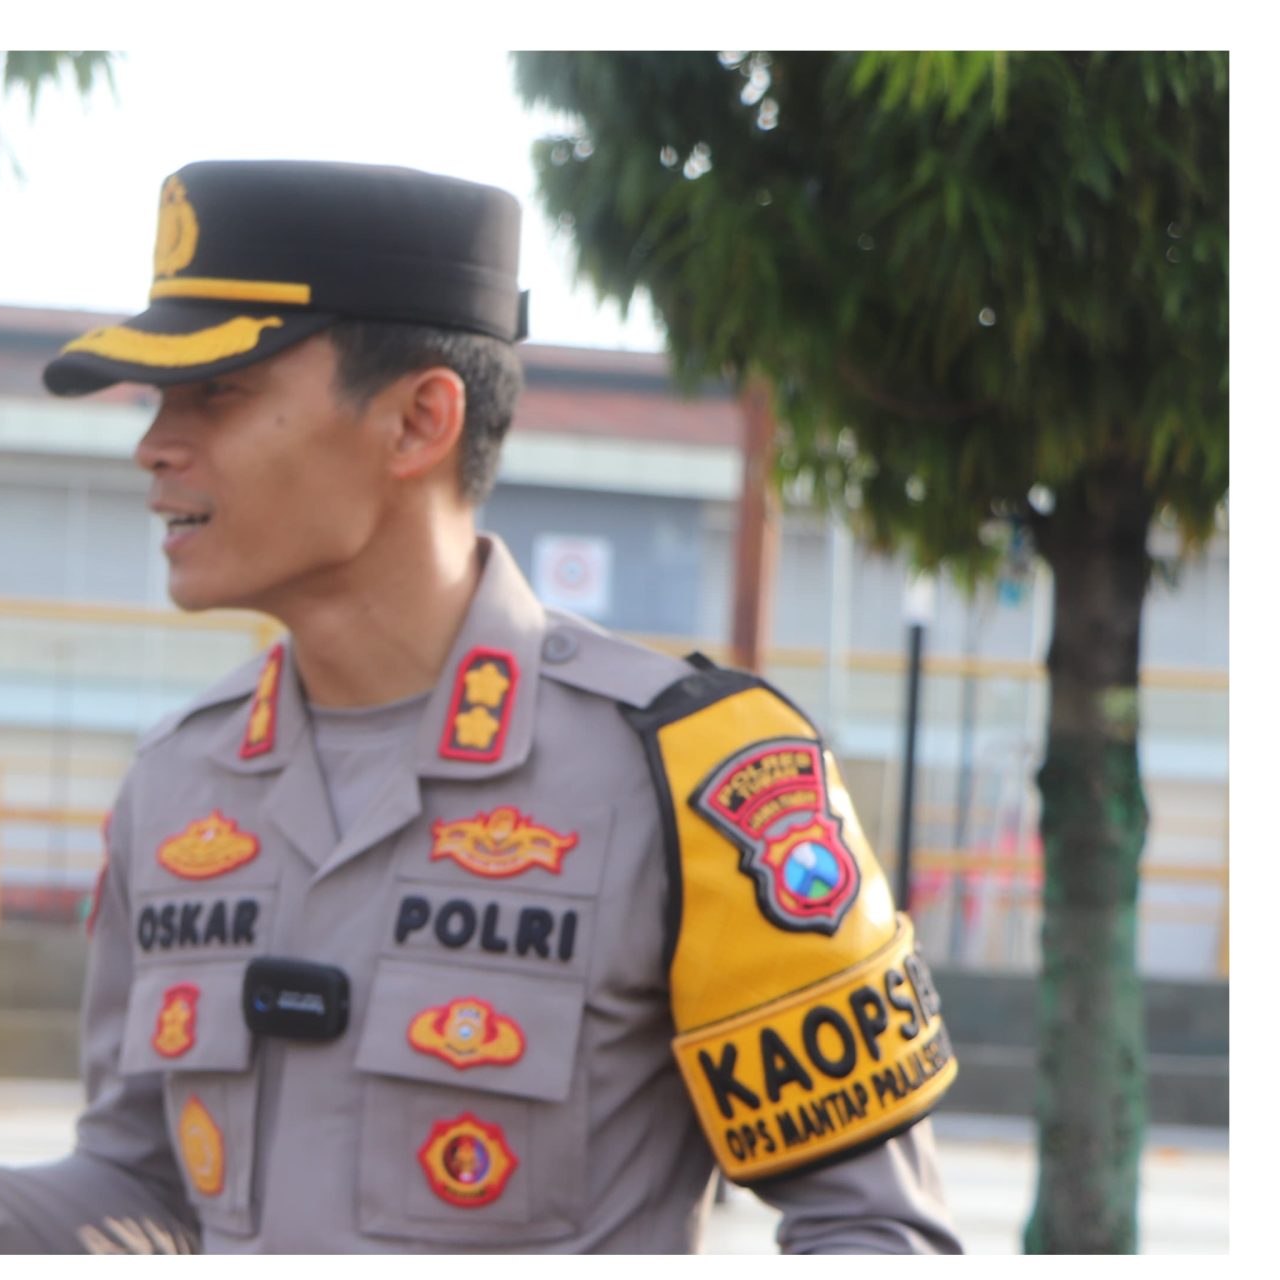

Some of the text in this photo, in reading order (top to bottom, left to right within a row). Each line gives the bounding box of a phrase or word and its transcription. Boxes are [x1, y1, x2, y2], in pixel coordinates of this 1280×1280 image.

[137, 897, 261, 952] OSKAR
[393, 894, 579, 963] POLRI
[725, 1120, 776, 1162] OPS
